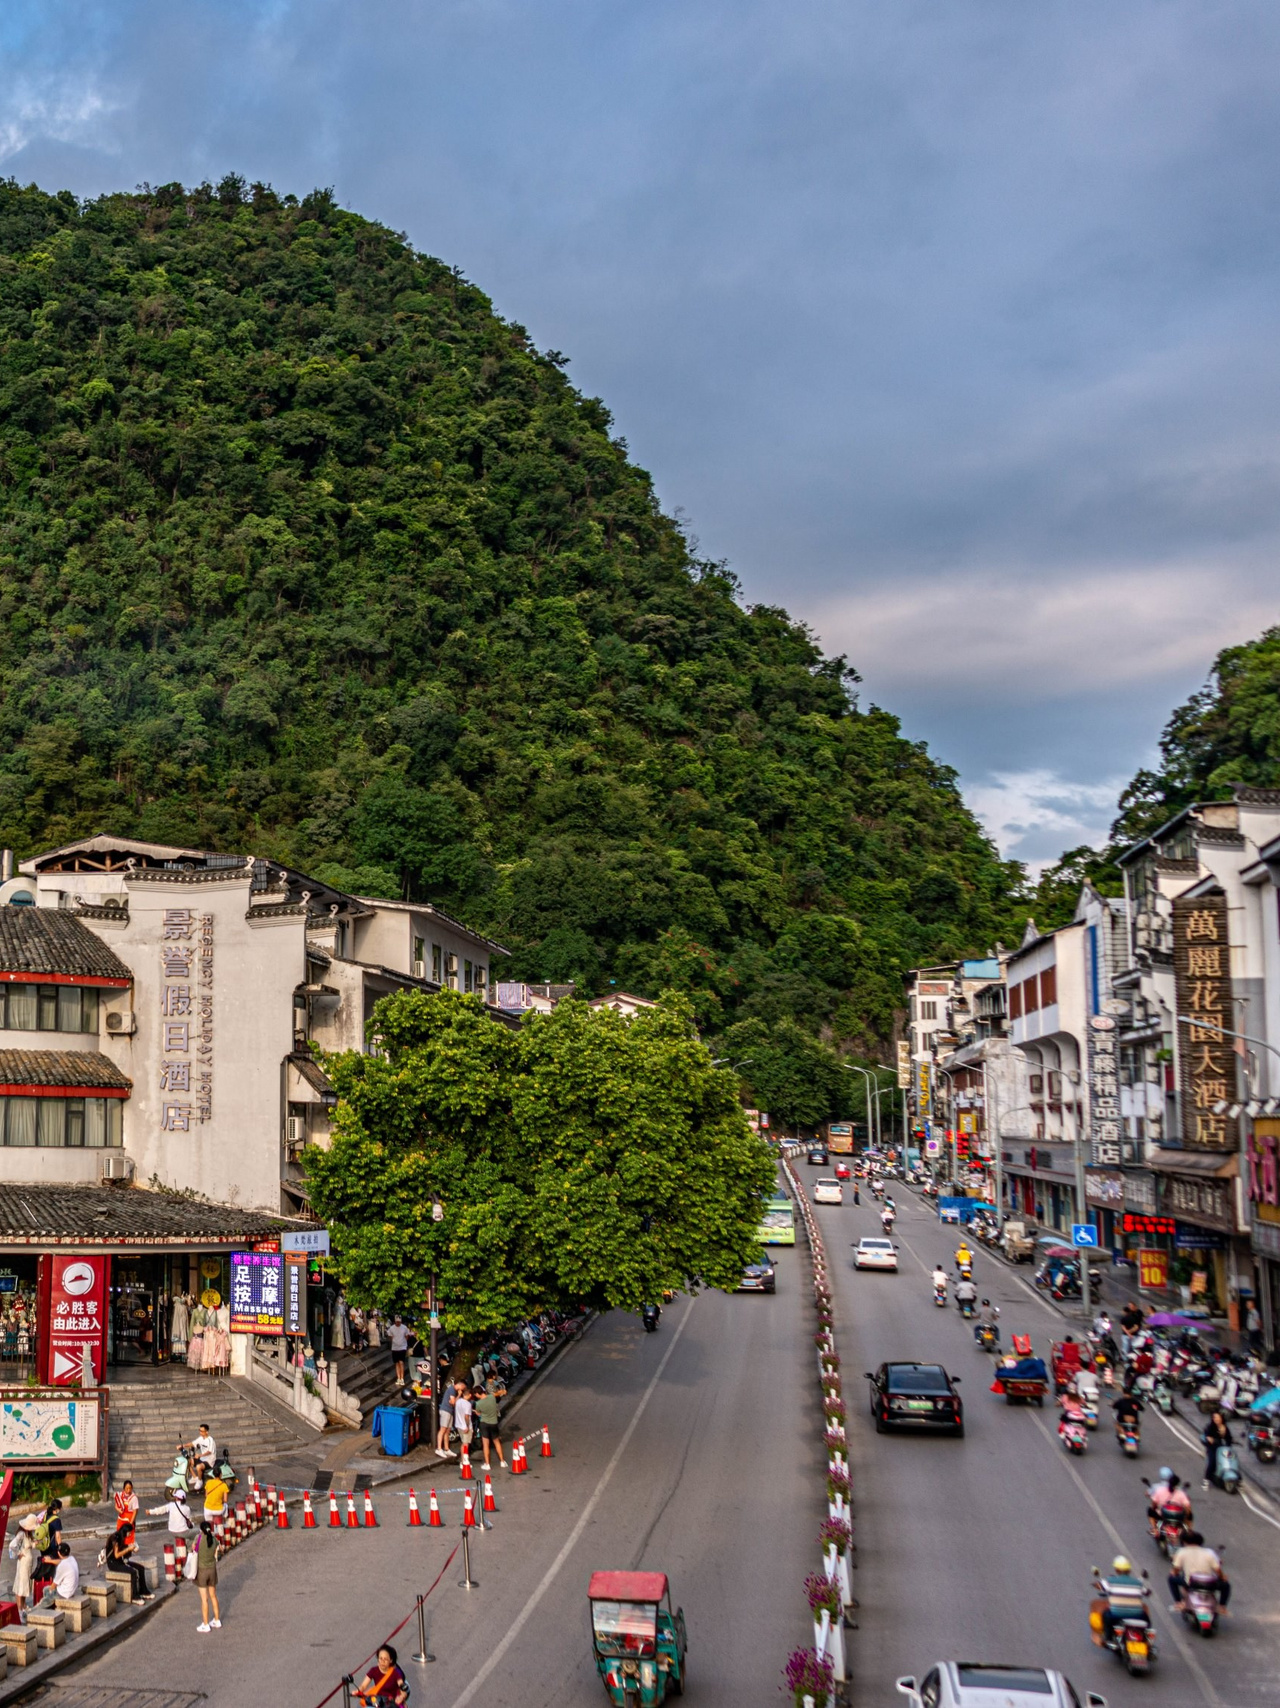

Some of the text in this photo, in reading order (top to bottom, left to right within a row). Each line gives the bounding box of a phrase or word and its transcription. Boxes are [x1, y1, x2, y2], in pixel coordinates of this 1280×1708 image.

[160, 908, 192, 1131] 景誉假日酒店
[198, 914, 215, 1125] REGENCY HOLIDAY HOTEL
[1185, 910, 1226, 1143] 萬麗花園大酒店
[1092, 1031, 1120, 1164] 青藤精品酒店
[235, 1266, 279, 1285] 足浴
[234, 1285, 279, 1305] 按摩
[56, 1301, 98, 1315] 必胜客
[234, 1303, 281, 1315] Massage
[53, 1317, 101, 1331] 由此进入
